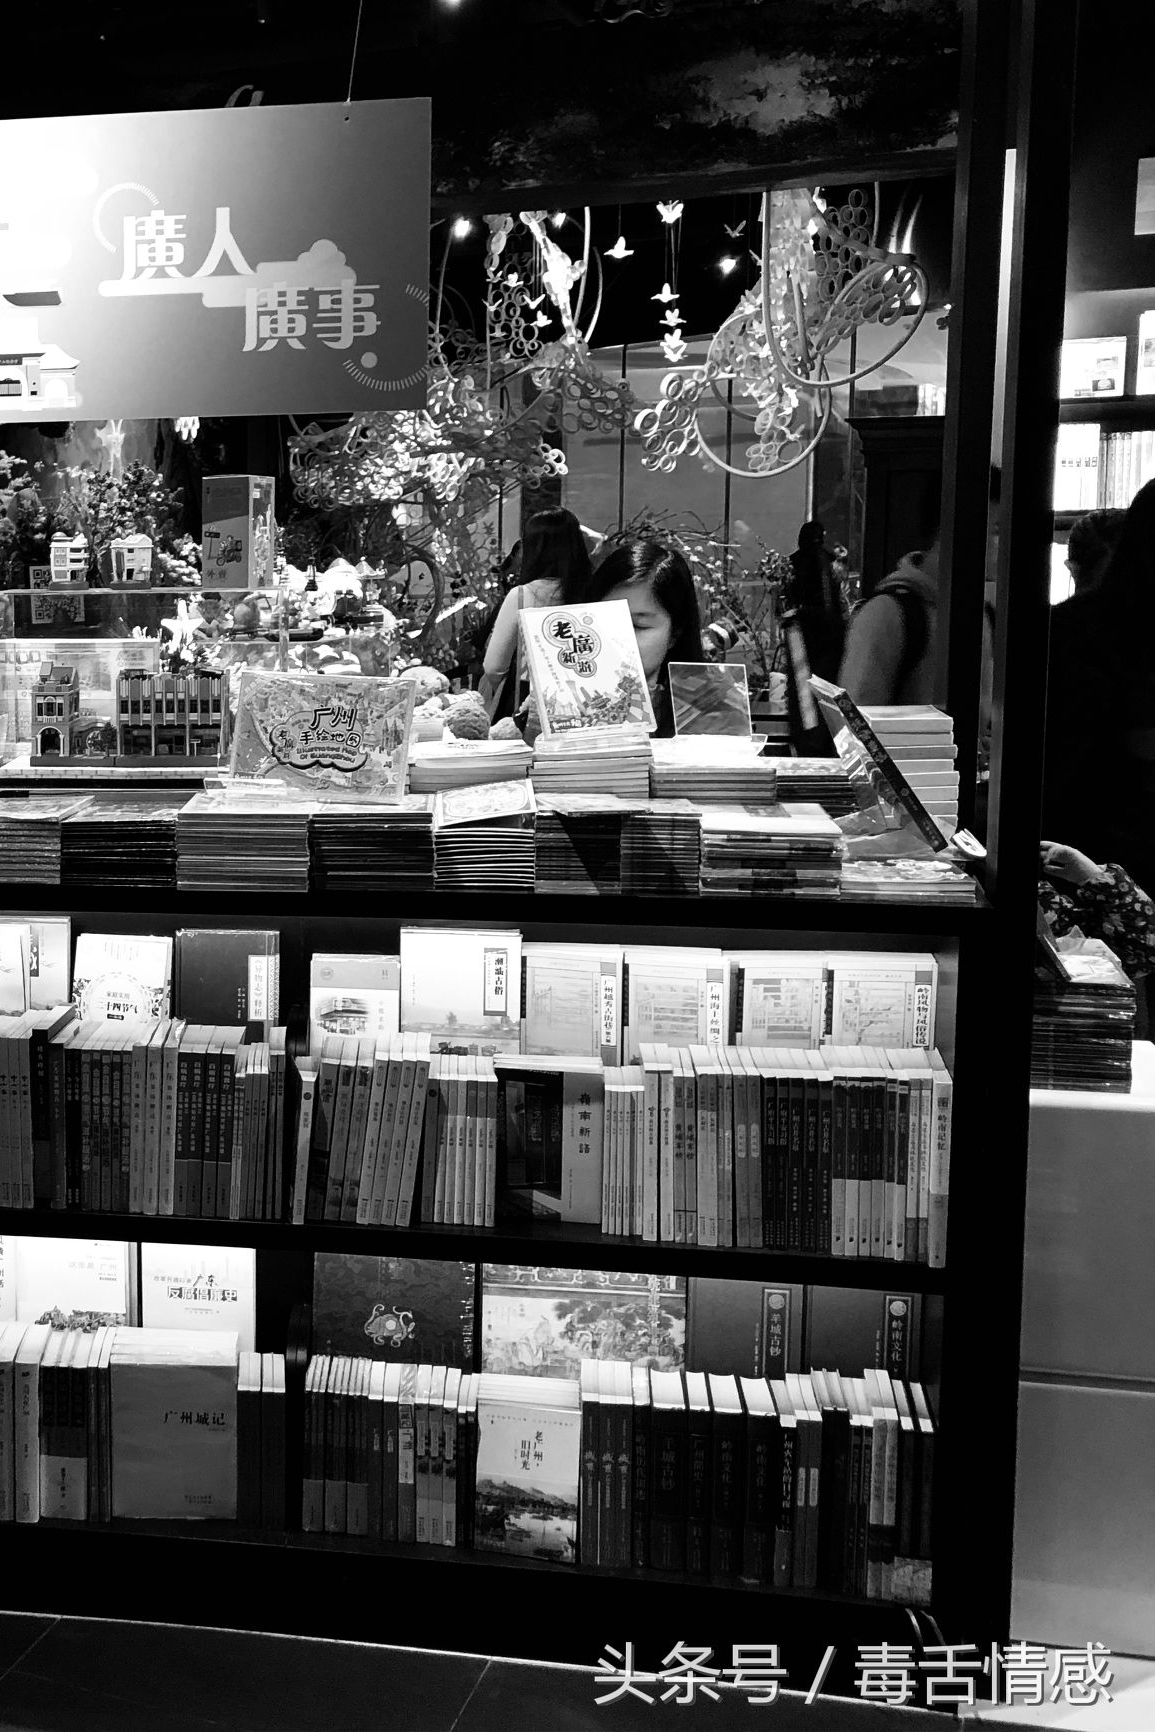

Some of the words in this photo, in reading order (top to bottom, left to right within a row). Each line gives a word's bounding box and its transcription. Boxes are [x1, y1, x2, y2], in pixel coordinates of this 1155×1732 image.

[120, 207, 256, 280] 廣人
[243, 278, 382, 351] 廣事
[310, 705, 358, 731] 广州
[299, 729, 361, 748] 手绘地图
[164, 1410, 226, 1427] 广州城记
